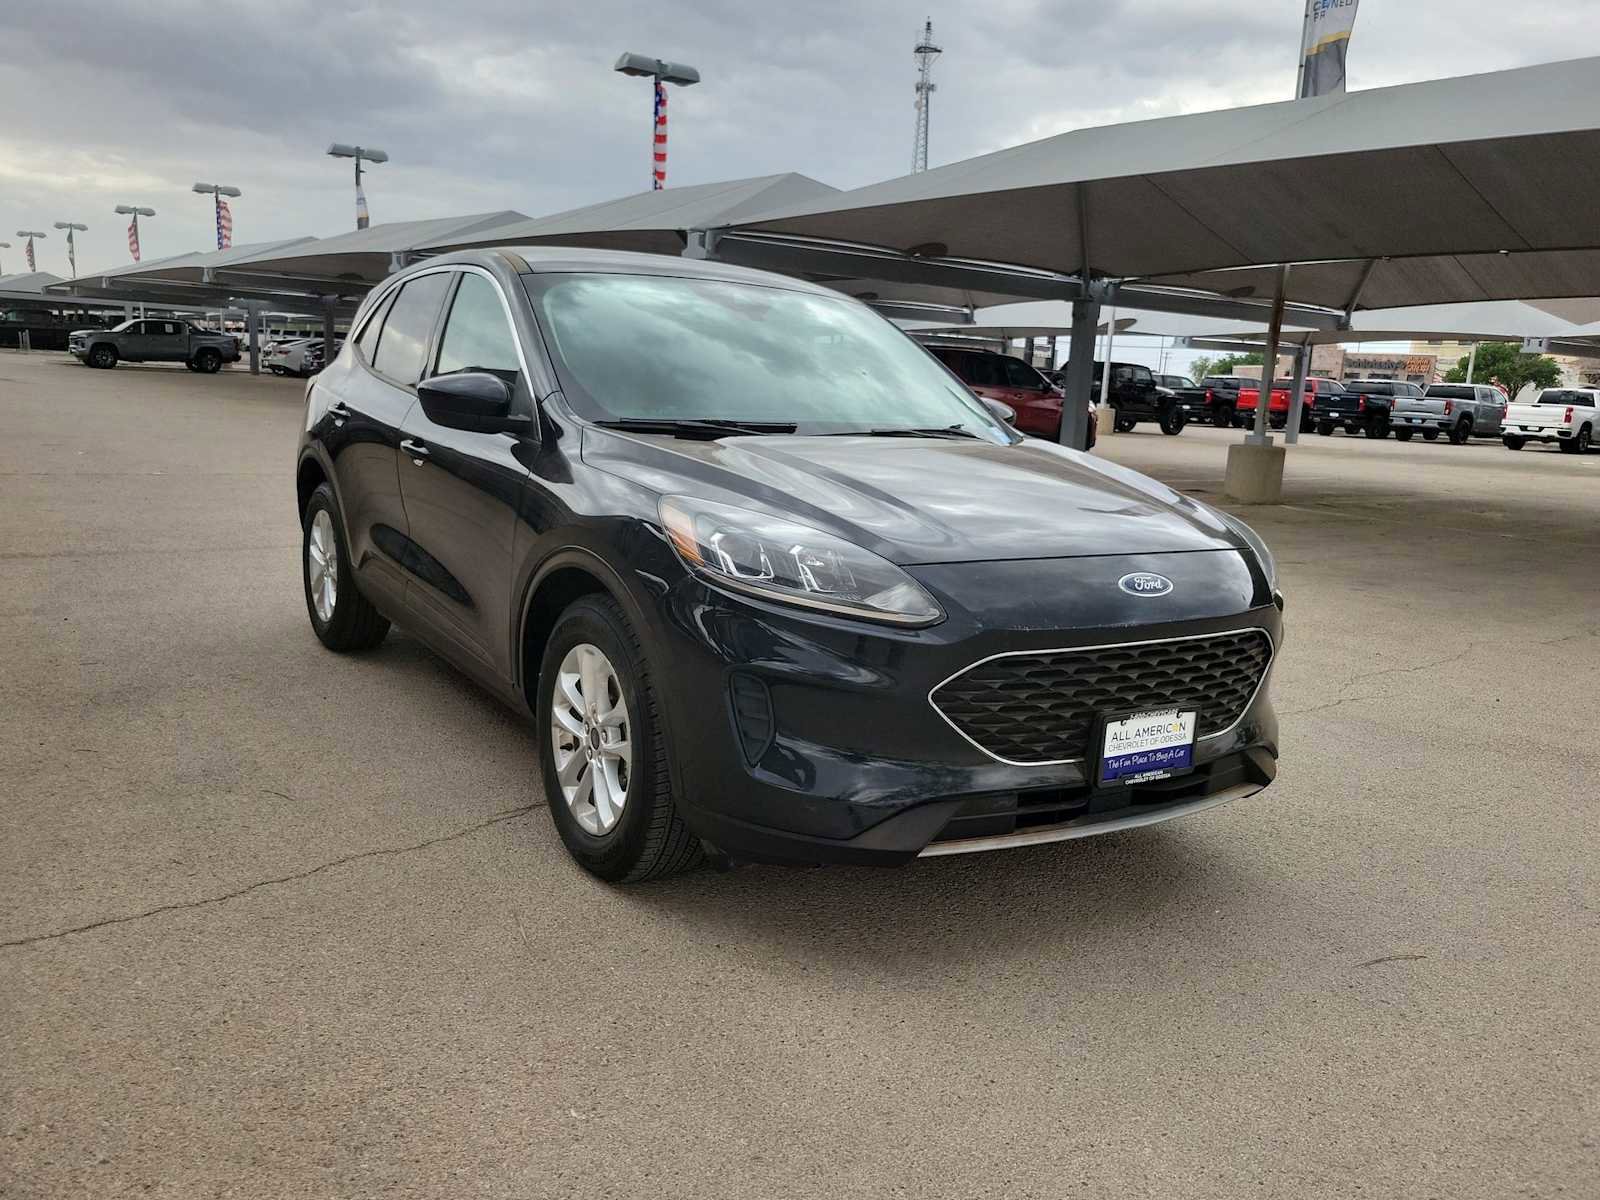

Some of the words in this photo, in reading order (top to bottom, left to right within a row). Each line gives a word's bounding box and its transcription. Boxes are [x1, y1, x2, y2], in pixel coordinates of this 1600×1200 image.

[1134, 576, 1163, 590] Ford
[1109, 739, 1148, 752] CHEVROLET
[1150, 737, 1159, 745] OF
[1161, 733, 1187, 743] ODESSA
[1112, 731, 1131, 741] ALL
[1108, 759, 1119, 769] The
[1132, 755, 1148, 766] Place
[1148, 752, 1155, 762] To
[1155, 752, 1168, 763] Buy
[1168, 750, 1174, 759] A
[1174, 748, 1185, 758] Car
